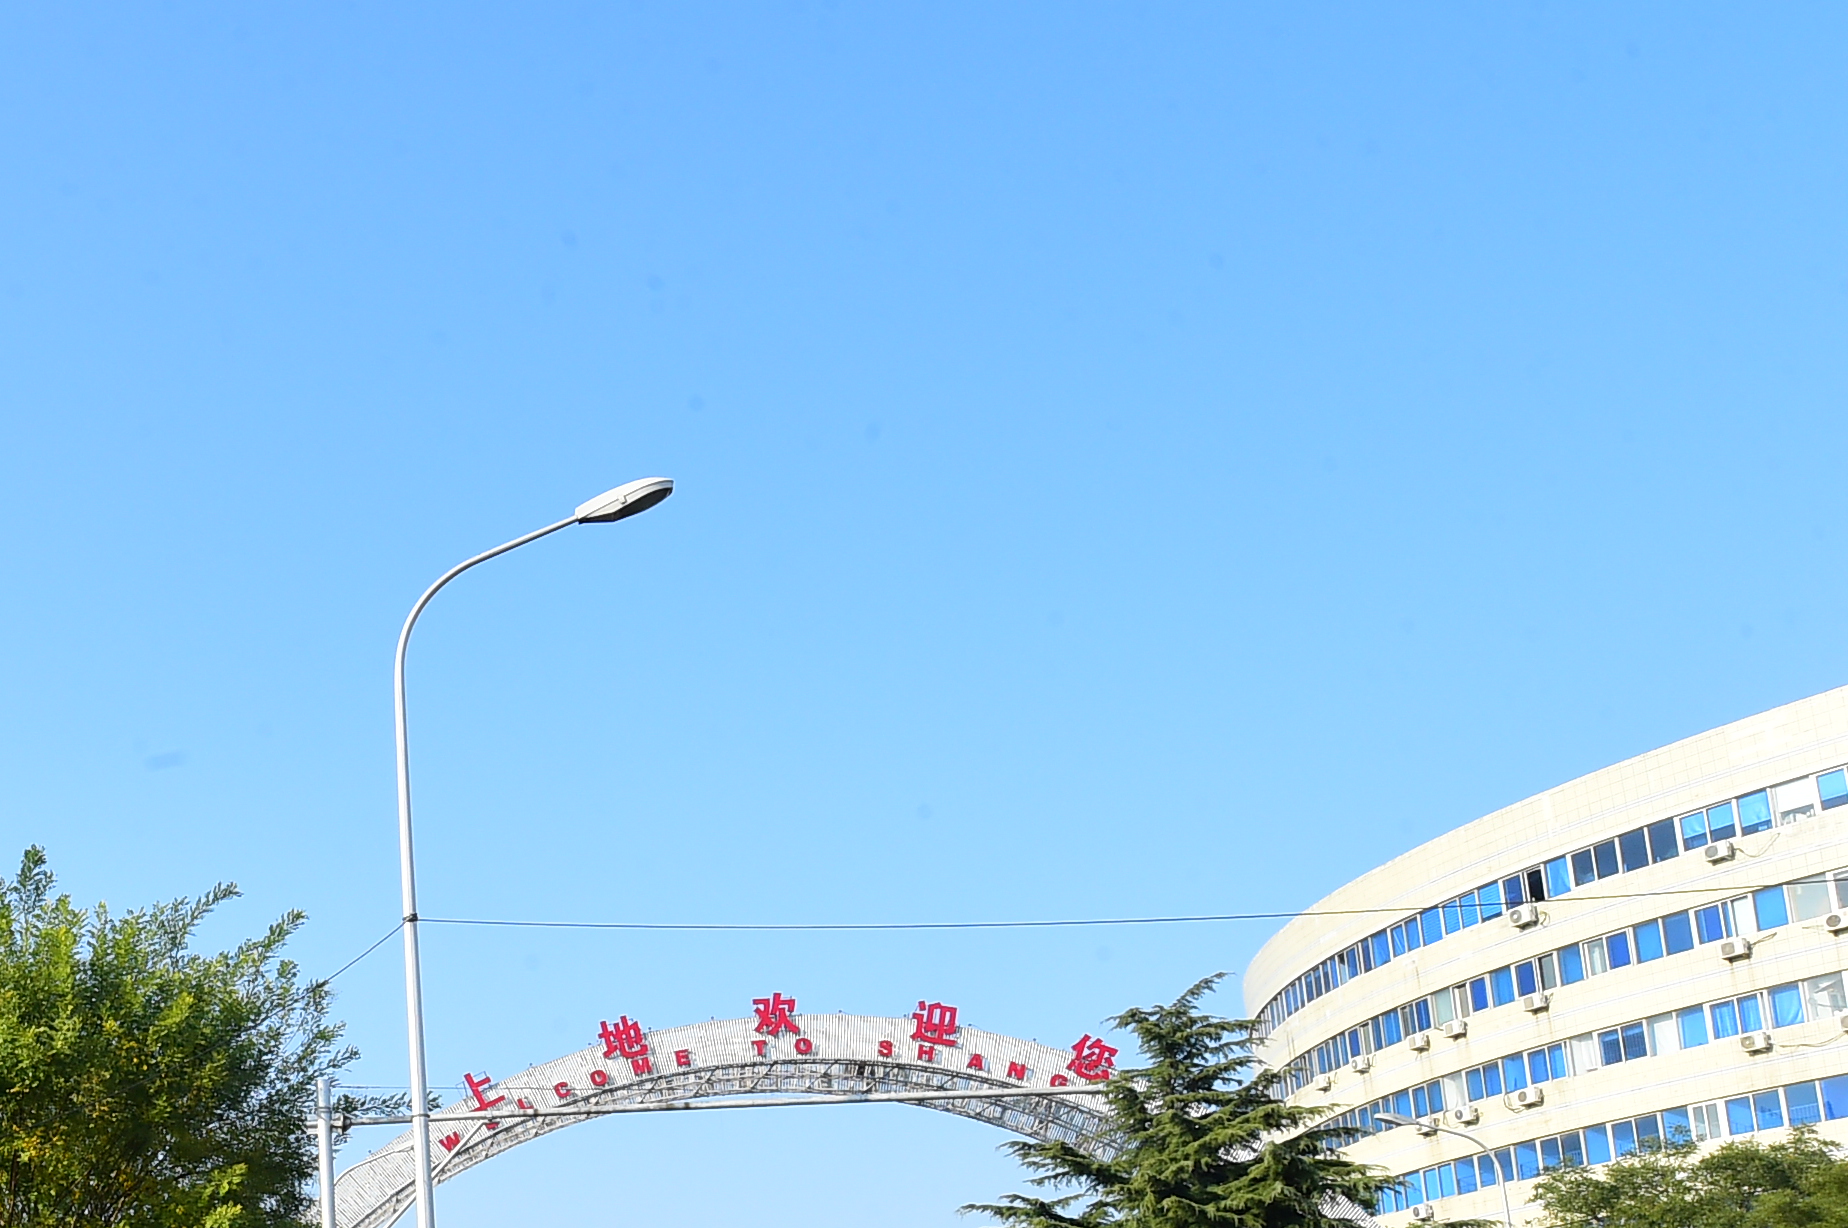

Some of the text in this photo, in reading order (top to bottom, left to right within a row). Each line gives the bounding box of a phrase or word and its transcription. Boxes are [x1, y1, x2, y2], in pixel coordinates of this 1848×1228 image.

[464, 992, 1118, 1112] 上地欢迎您
[752, 1038, 813, 1056] TO
